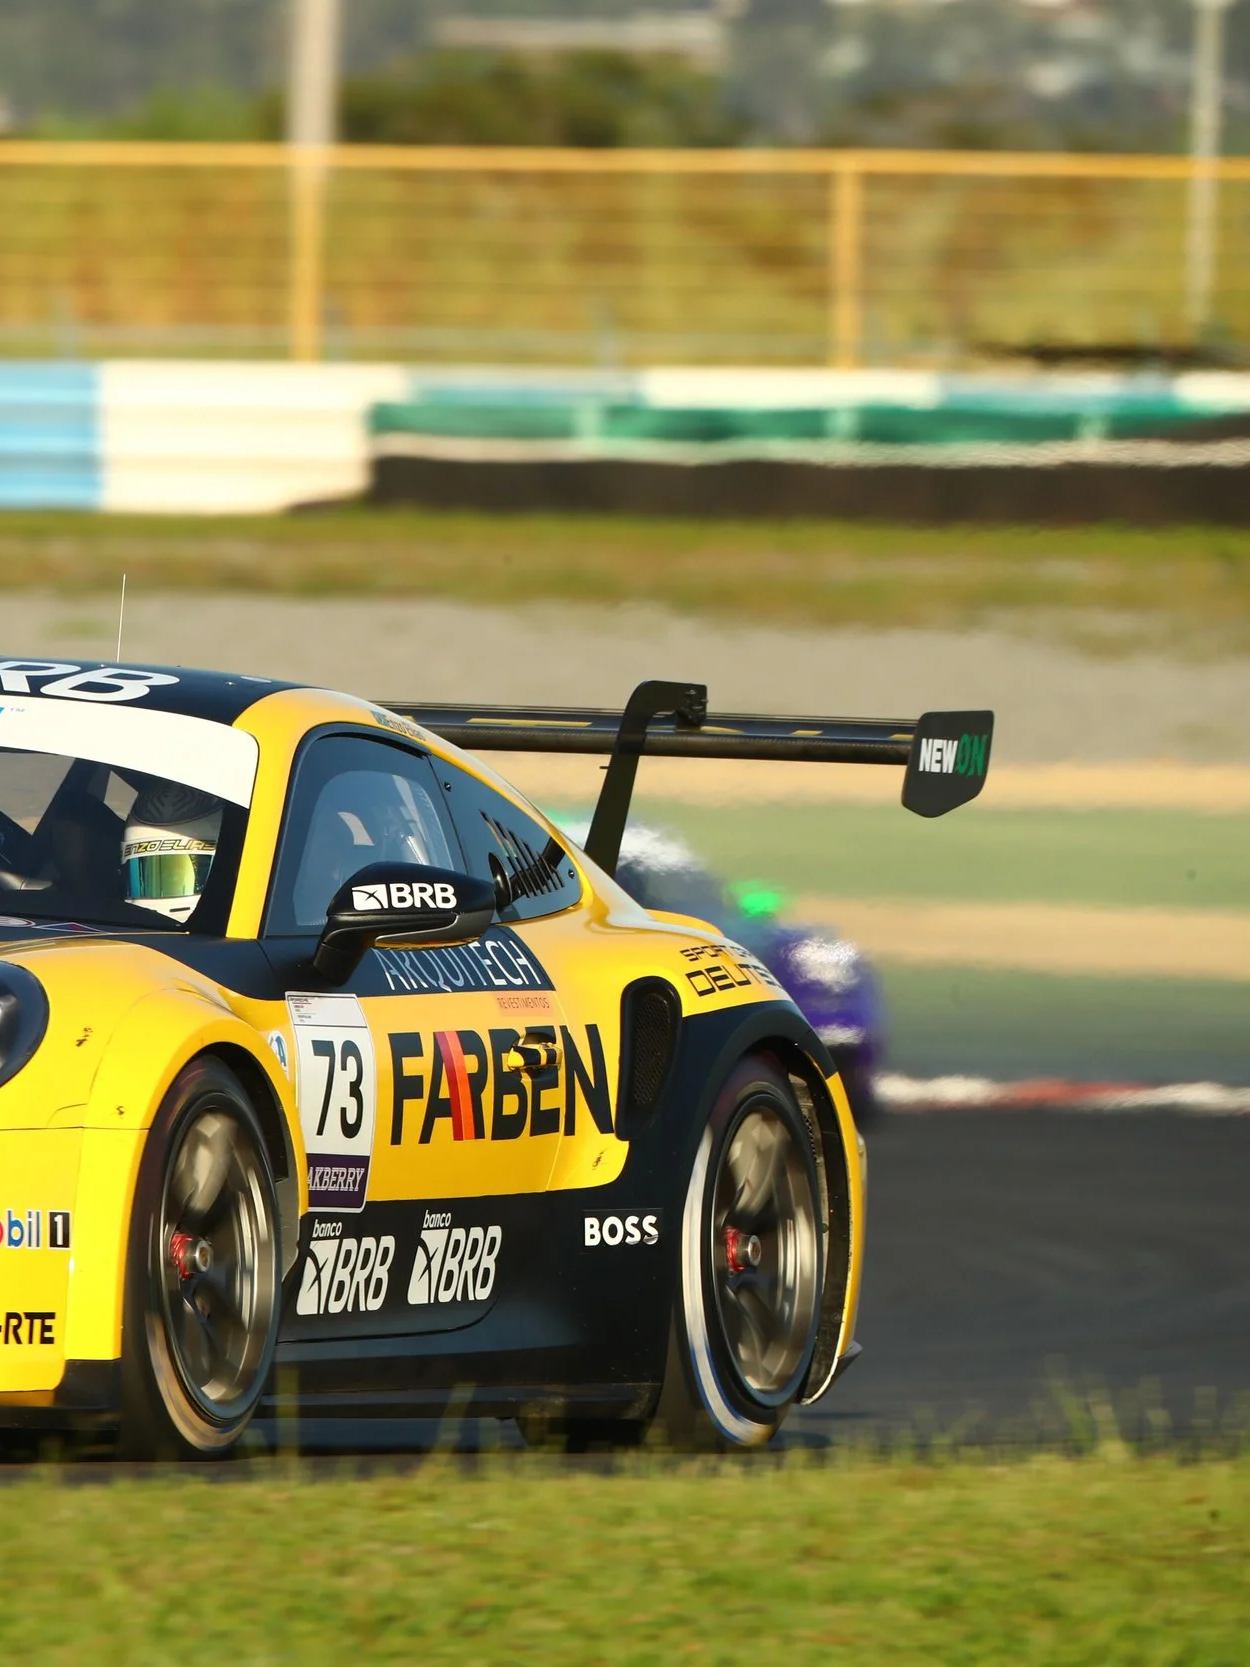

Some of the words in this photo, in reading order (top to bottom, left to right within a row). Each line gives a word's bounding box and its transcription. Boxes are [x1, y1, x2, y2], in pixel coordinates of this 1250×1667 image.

[389, 882, 457, 909] BRB
[370, 940, 542, 992] ARQUITECH
[311, 1039, 364, 1139] 73
[387, 1024, 614, 1146] FARBEN
[307, 1166, 366, 1192] AKBERRY
[312, 1219, 343, 1238] banco
[423, 1210, 452, 1228] banco
[584, 1214, 659, 1247] BOSS
[328, 1235, 396, 1314] BRB
[437, 1225, 502, 1304] BRB
